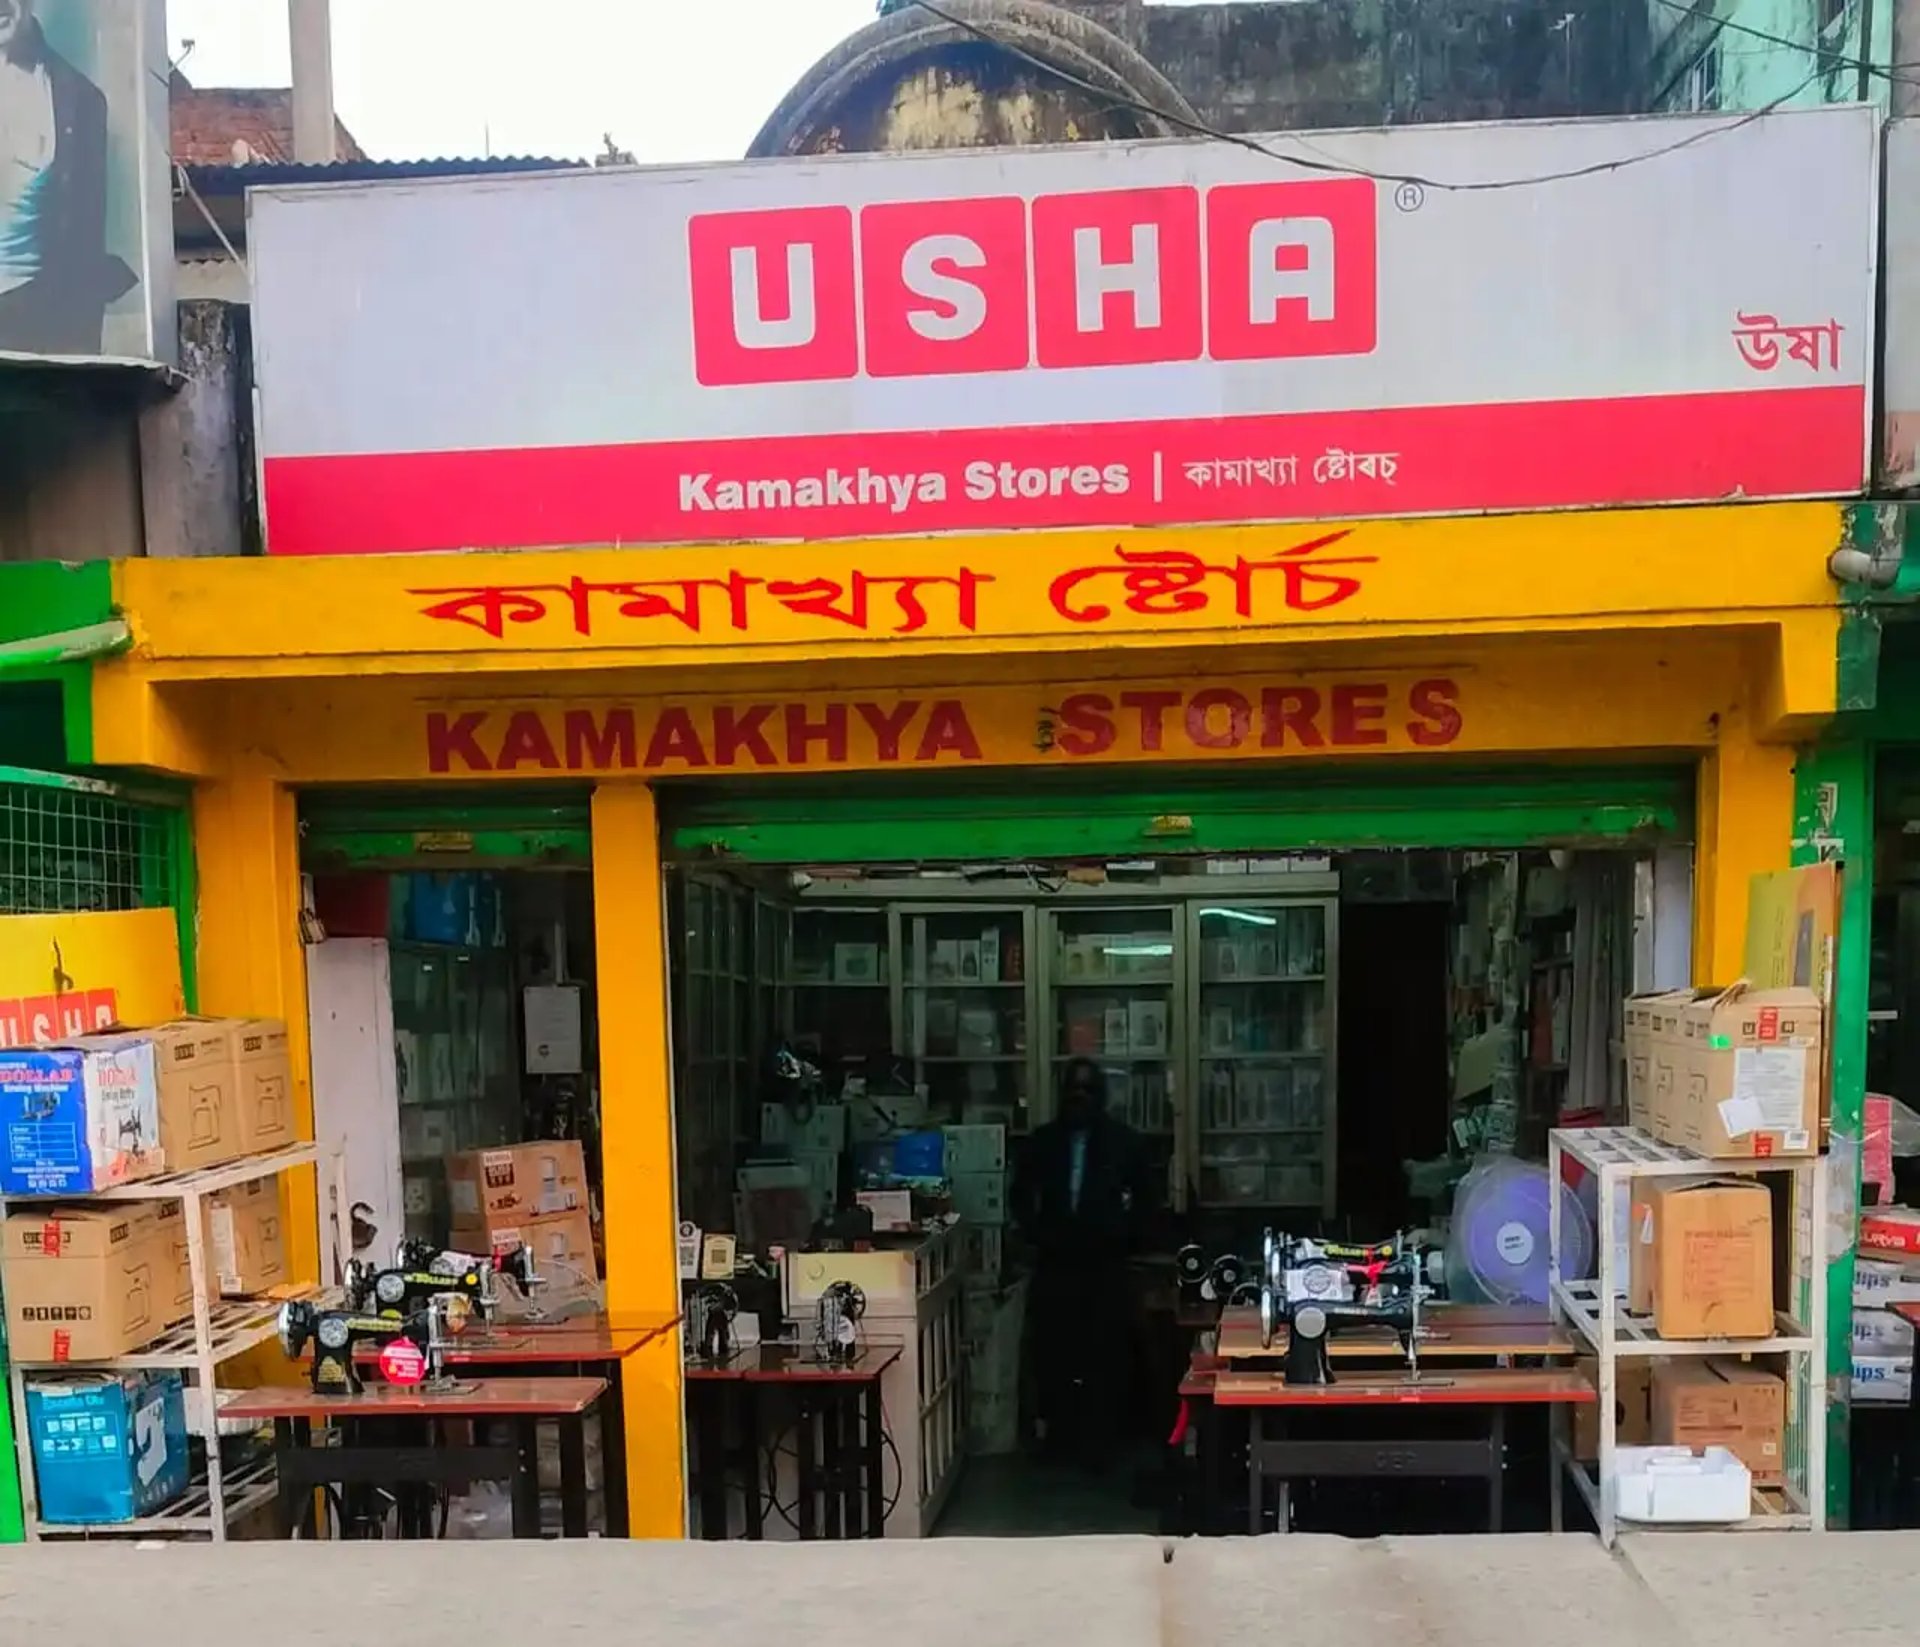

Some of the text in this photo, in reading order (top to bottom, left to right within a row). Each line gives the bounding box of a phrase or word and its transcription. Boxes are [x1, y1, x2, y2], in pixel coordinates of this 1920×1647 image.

[731, 215, 1335, 350] USHA
[1732, 311, 1845, 371] উষা
[678, 461, 1130, 513] Kamakhya Stores
[1182, 454, 1299, 488] কামাখ্যা
[405, 567, 995, 638] কামাখ্যা
[426, 700, 982, 773] KAMAKHYA
[1056, 678, 1463, 757] STORES
